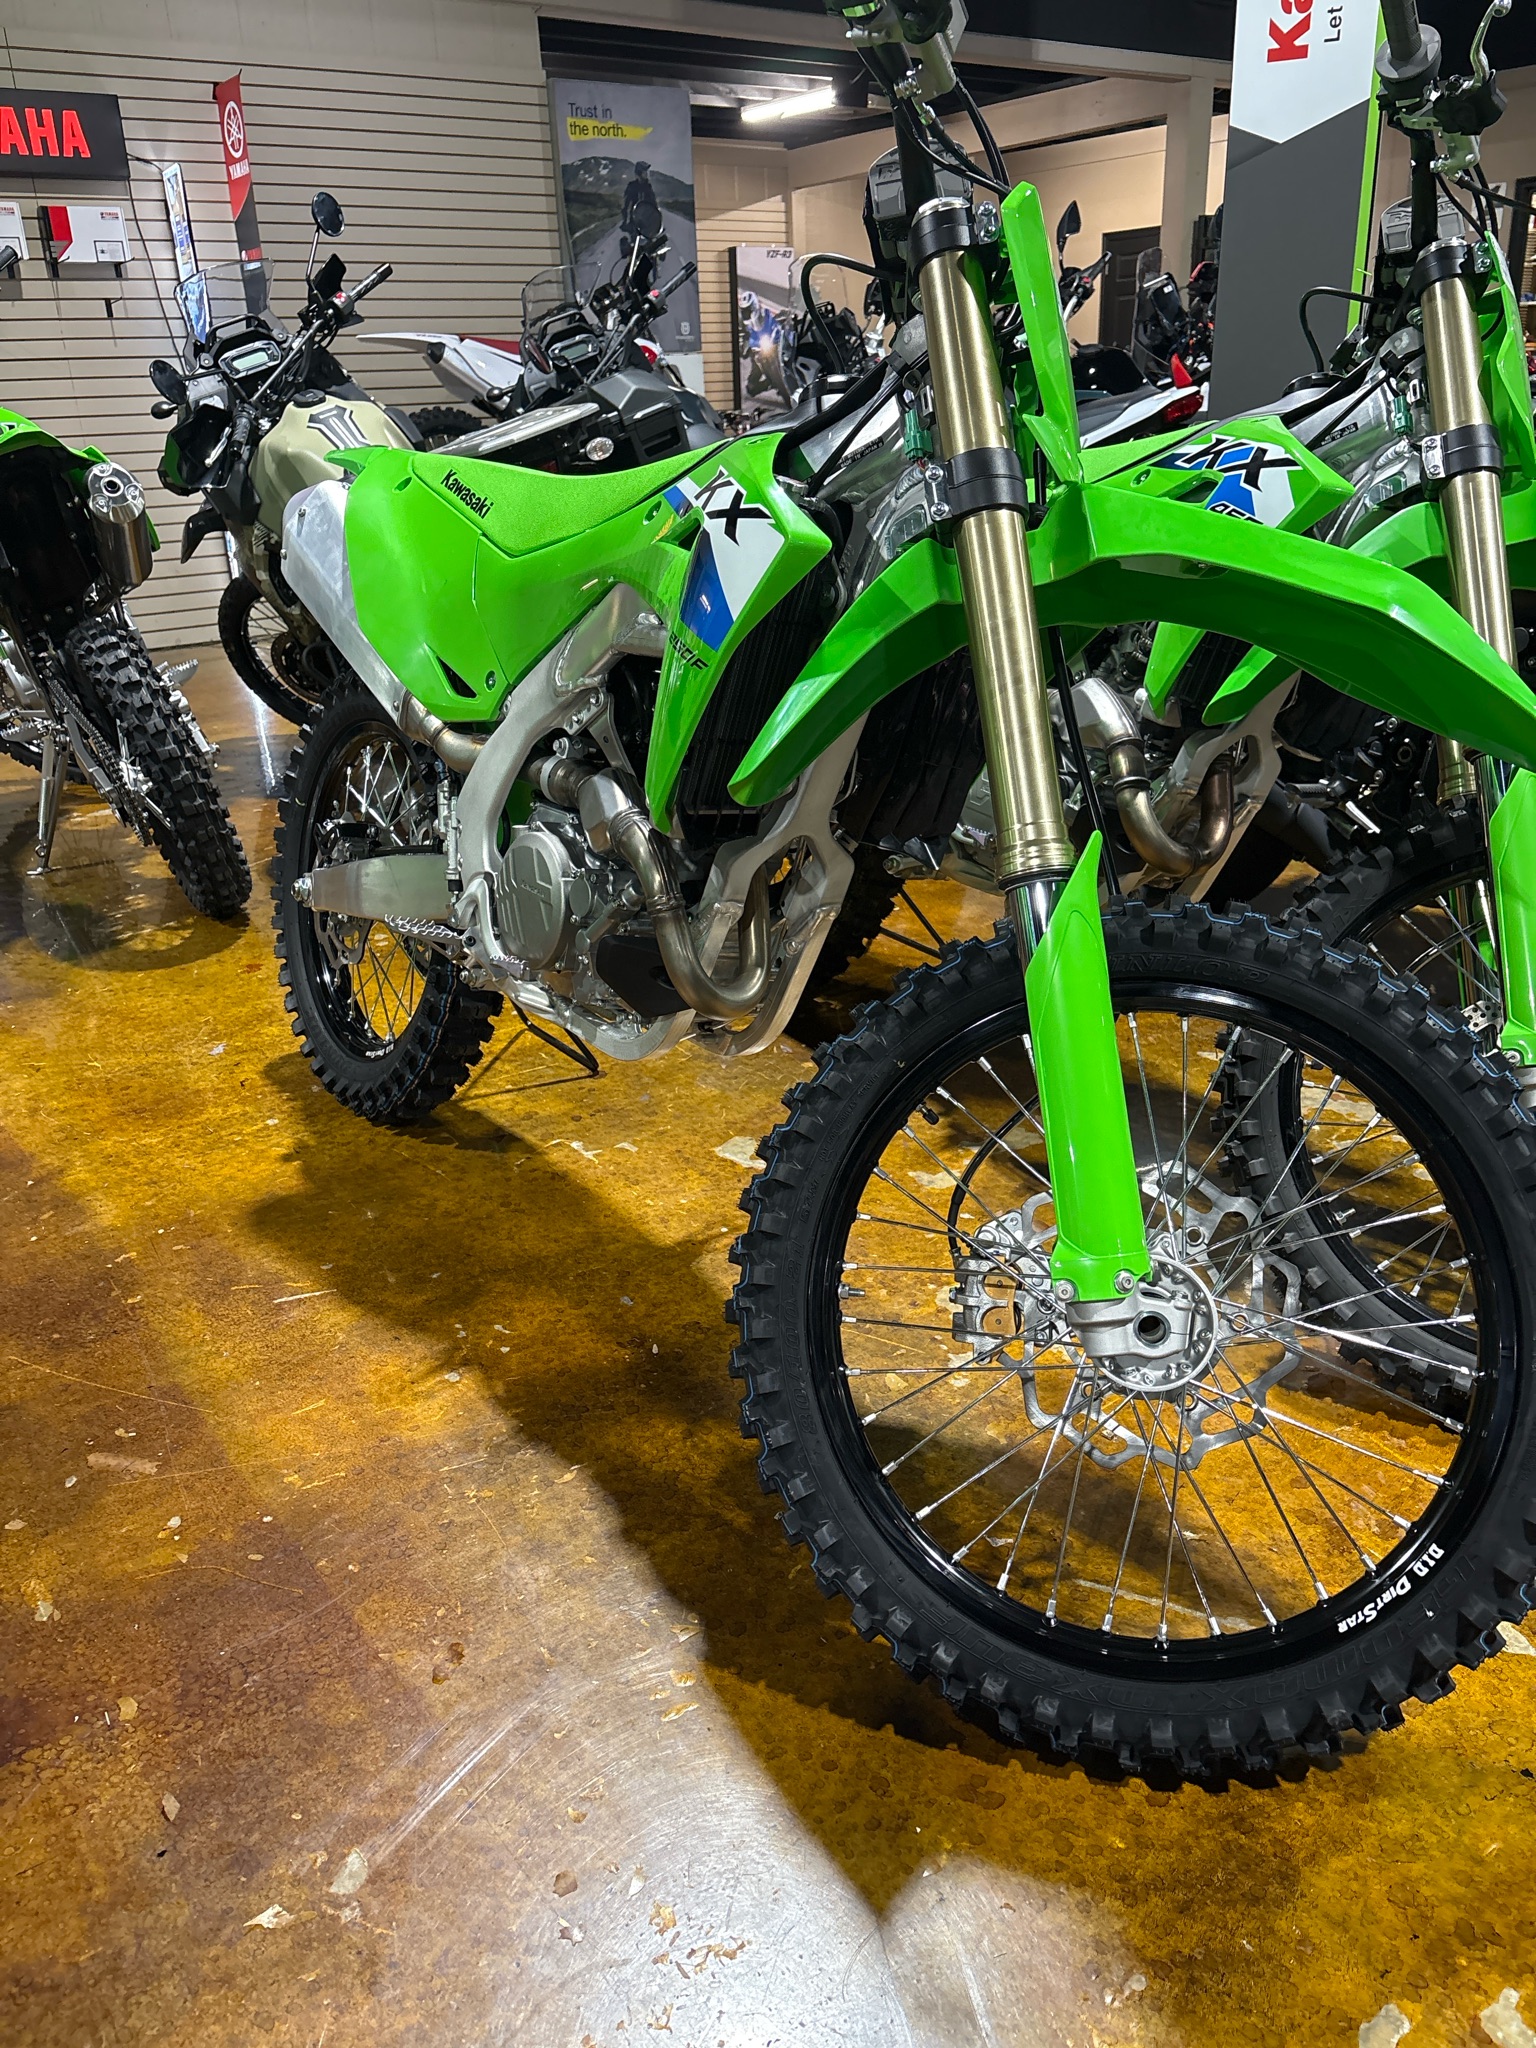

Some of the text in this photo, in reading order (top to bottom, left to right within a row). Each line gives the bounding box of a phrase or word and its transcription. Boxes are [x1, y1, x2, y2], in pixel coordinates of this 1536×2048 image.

[1324, 5, 1343, 43] Let
[567, 102, 613, 119] Trust in
[569, 120, 627, 138] the north.
[766, 249, 792, 259] YZF-R3
[1180, 437, 1301, 493] KX
[440, 469, 495, 520] Kawasaki
[694, 468, 773, 547] KX
